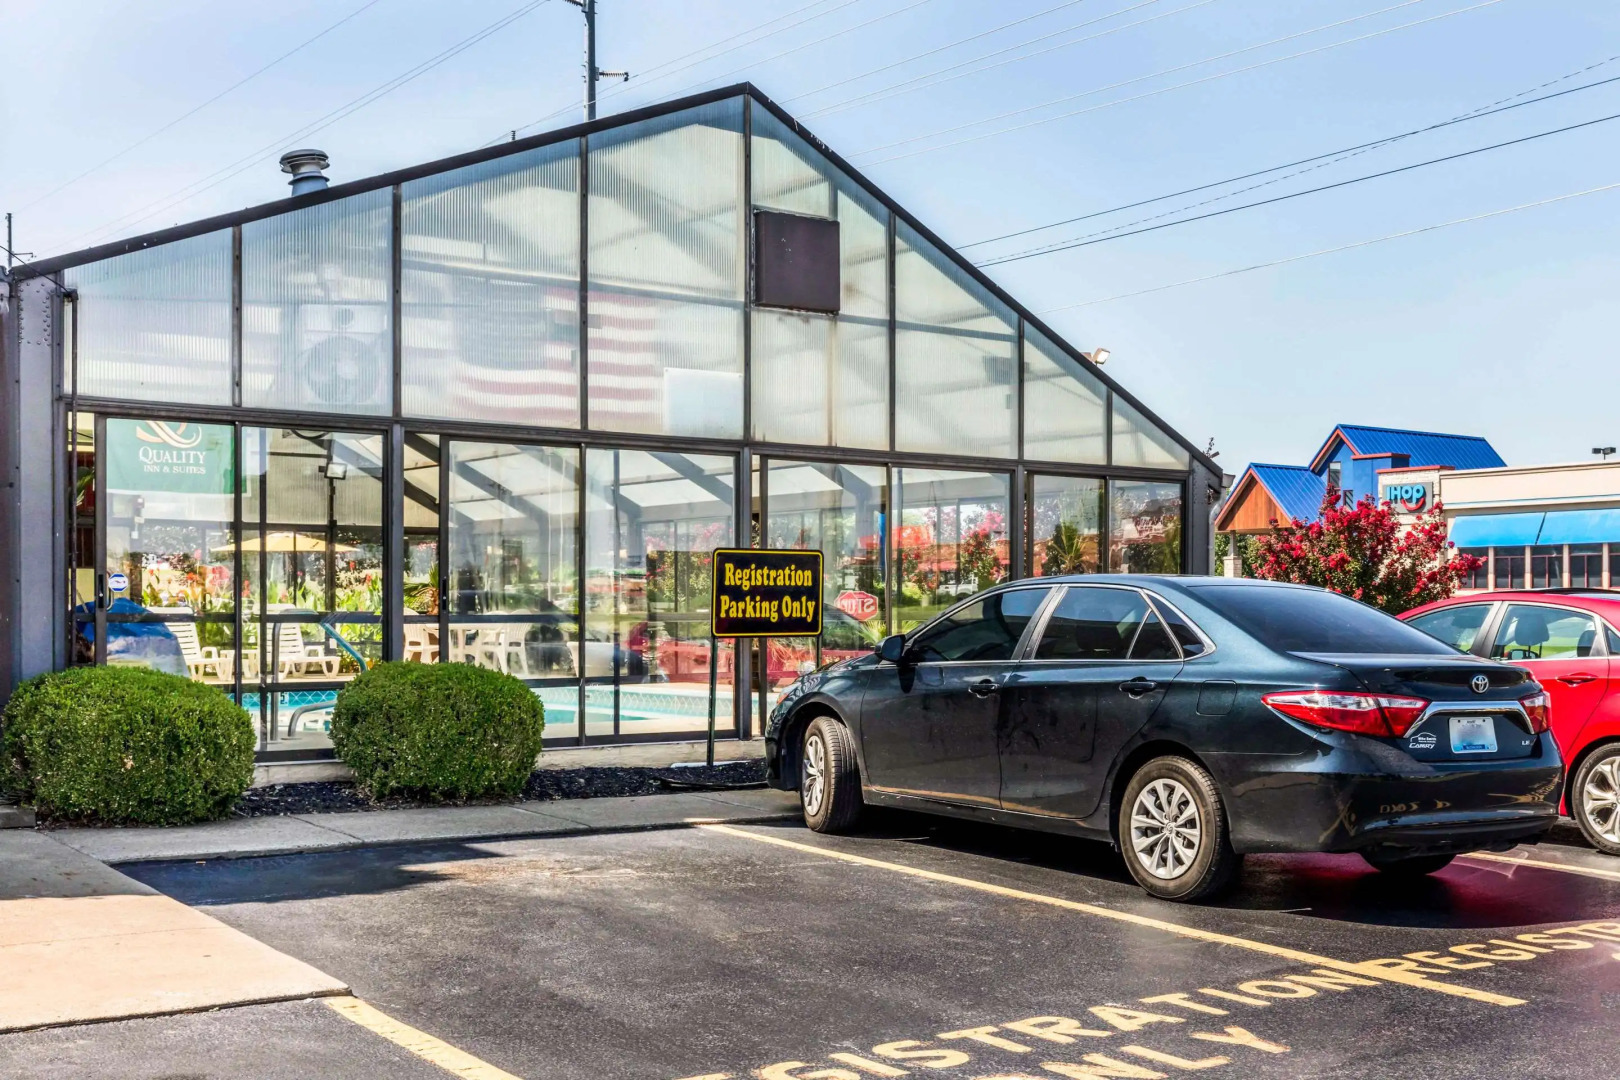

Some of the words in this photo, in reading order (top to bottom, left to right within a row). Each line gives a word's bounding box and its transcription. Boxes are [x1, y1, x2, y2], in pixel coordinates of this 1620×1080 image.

[139, 446, 205, 464] QUALITY
[144, 465, 160, 473] INN
[163, 466, 170, 474] &
[173, 466, 205, 475] SUITES
[1386, 485, 1424, 504] IHOP
[725, 563, 812, 590] Registration
[720, 595, 779, 622] Parking
[781, 595, 816, 622] Only
[972, 1026, 1291, 1080] NLY
